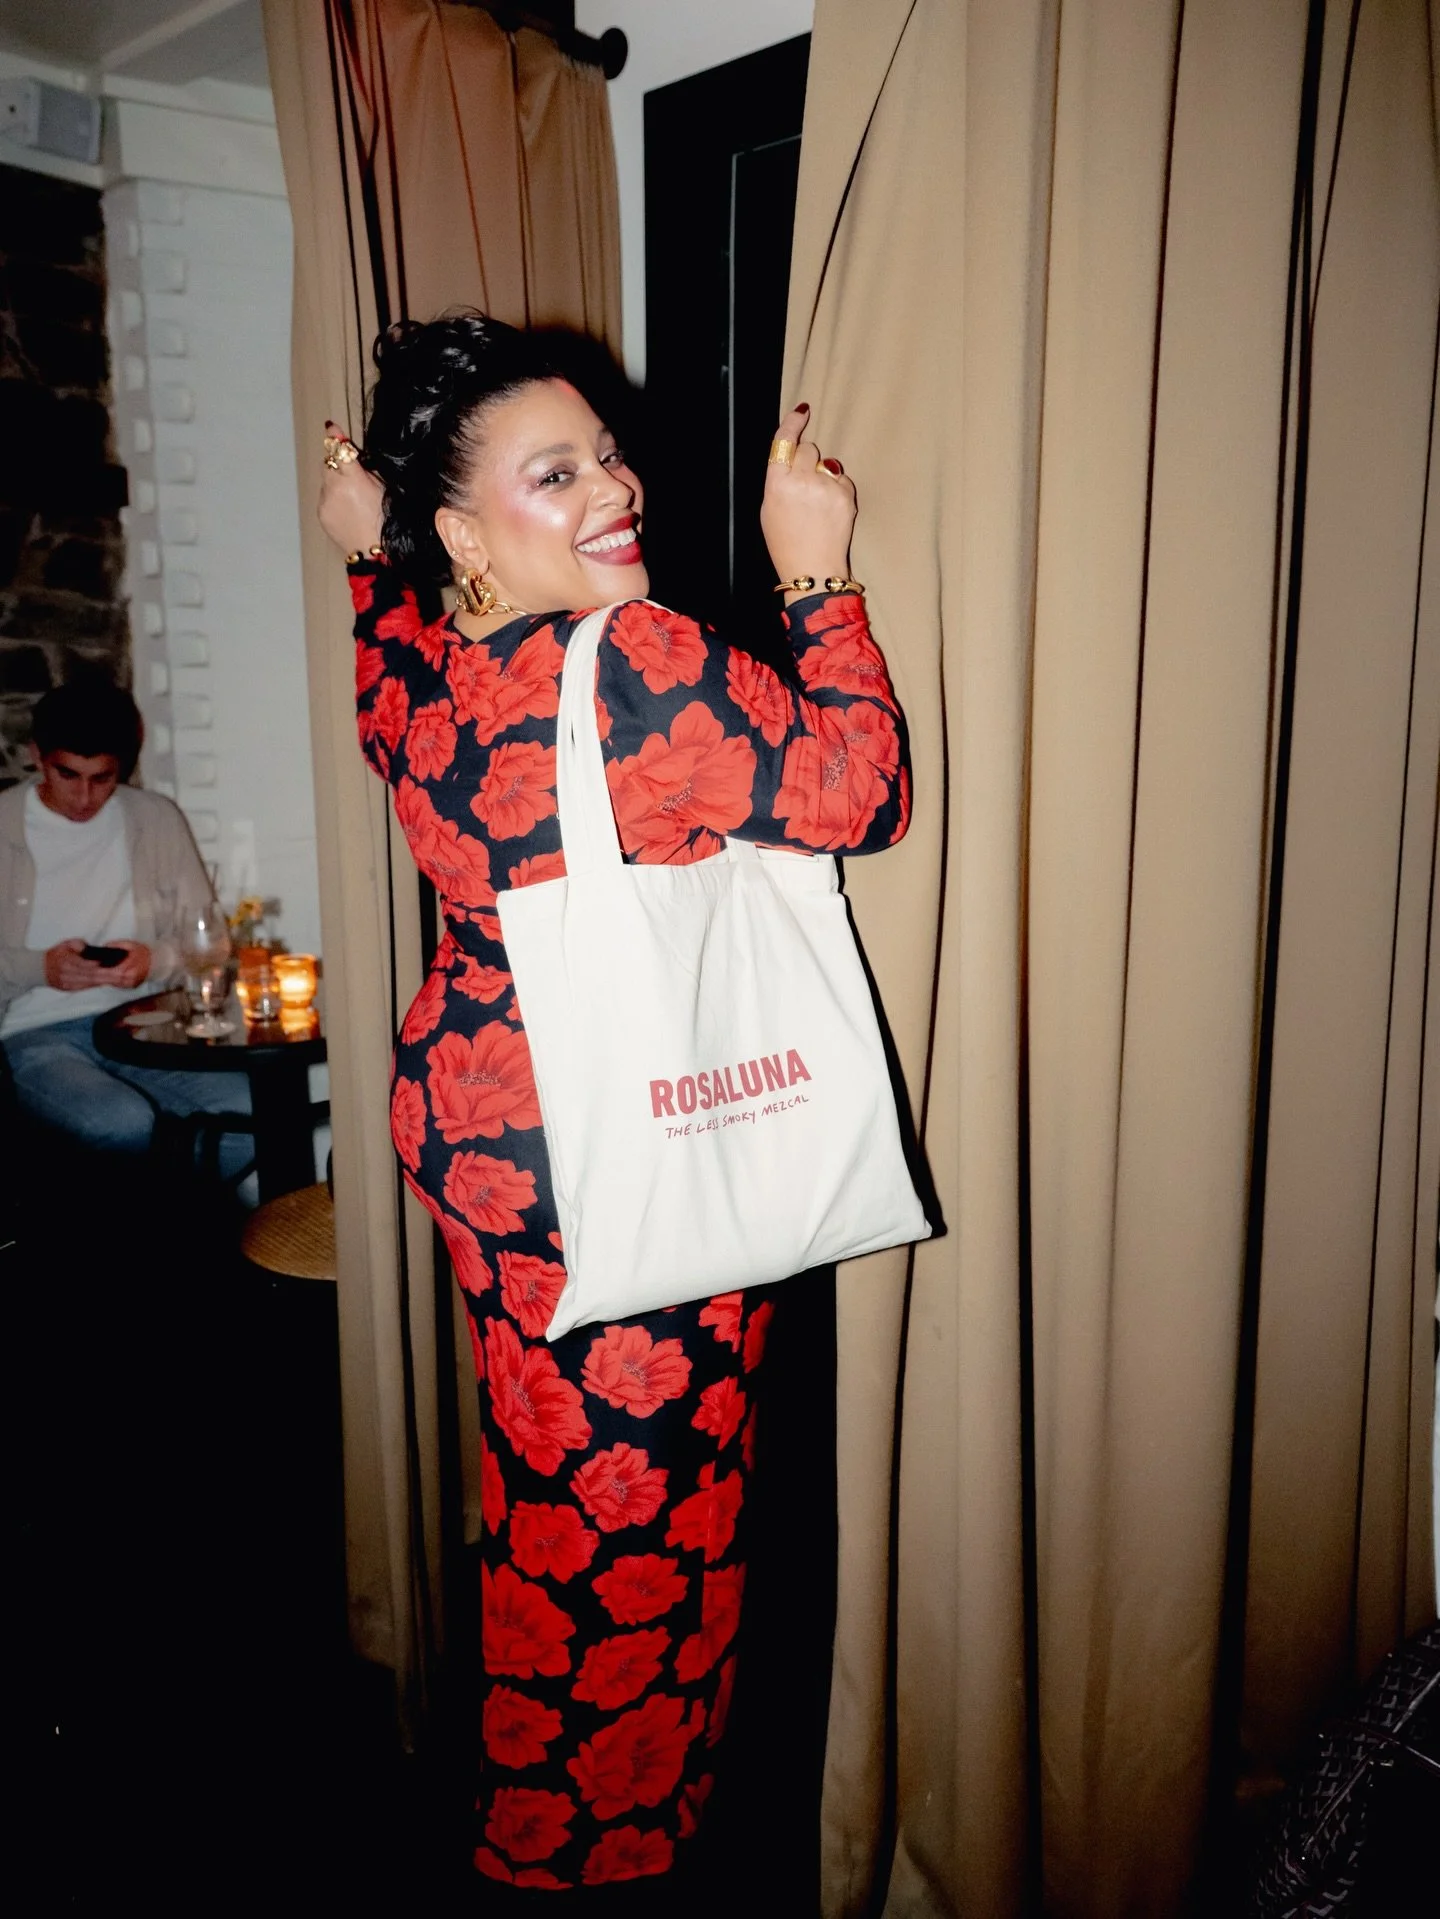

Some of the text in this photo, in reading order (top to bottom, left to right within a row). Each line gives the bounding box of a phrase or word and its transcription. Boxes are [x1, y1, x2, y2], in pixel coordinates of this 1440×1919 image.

[649, 1048, 812, 1118] ROSALUNA
[665, 1094, 809, 1139] THE LESS SMOKY MEZCAL
